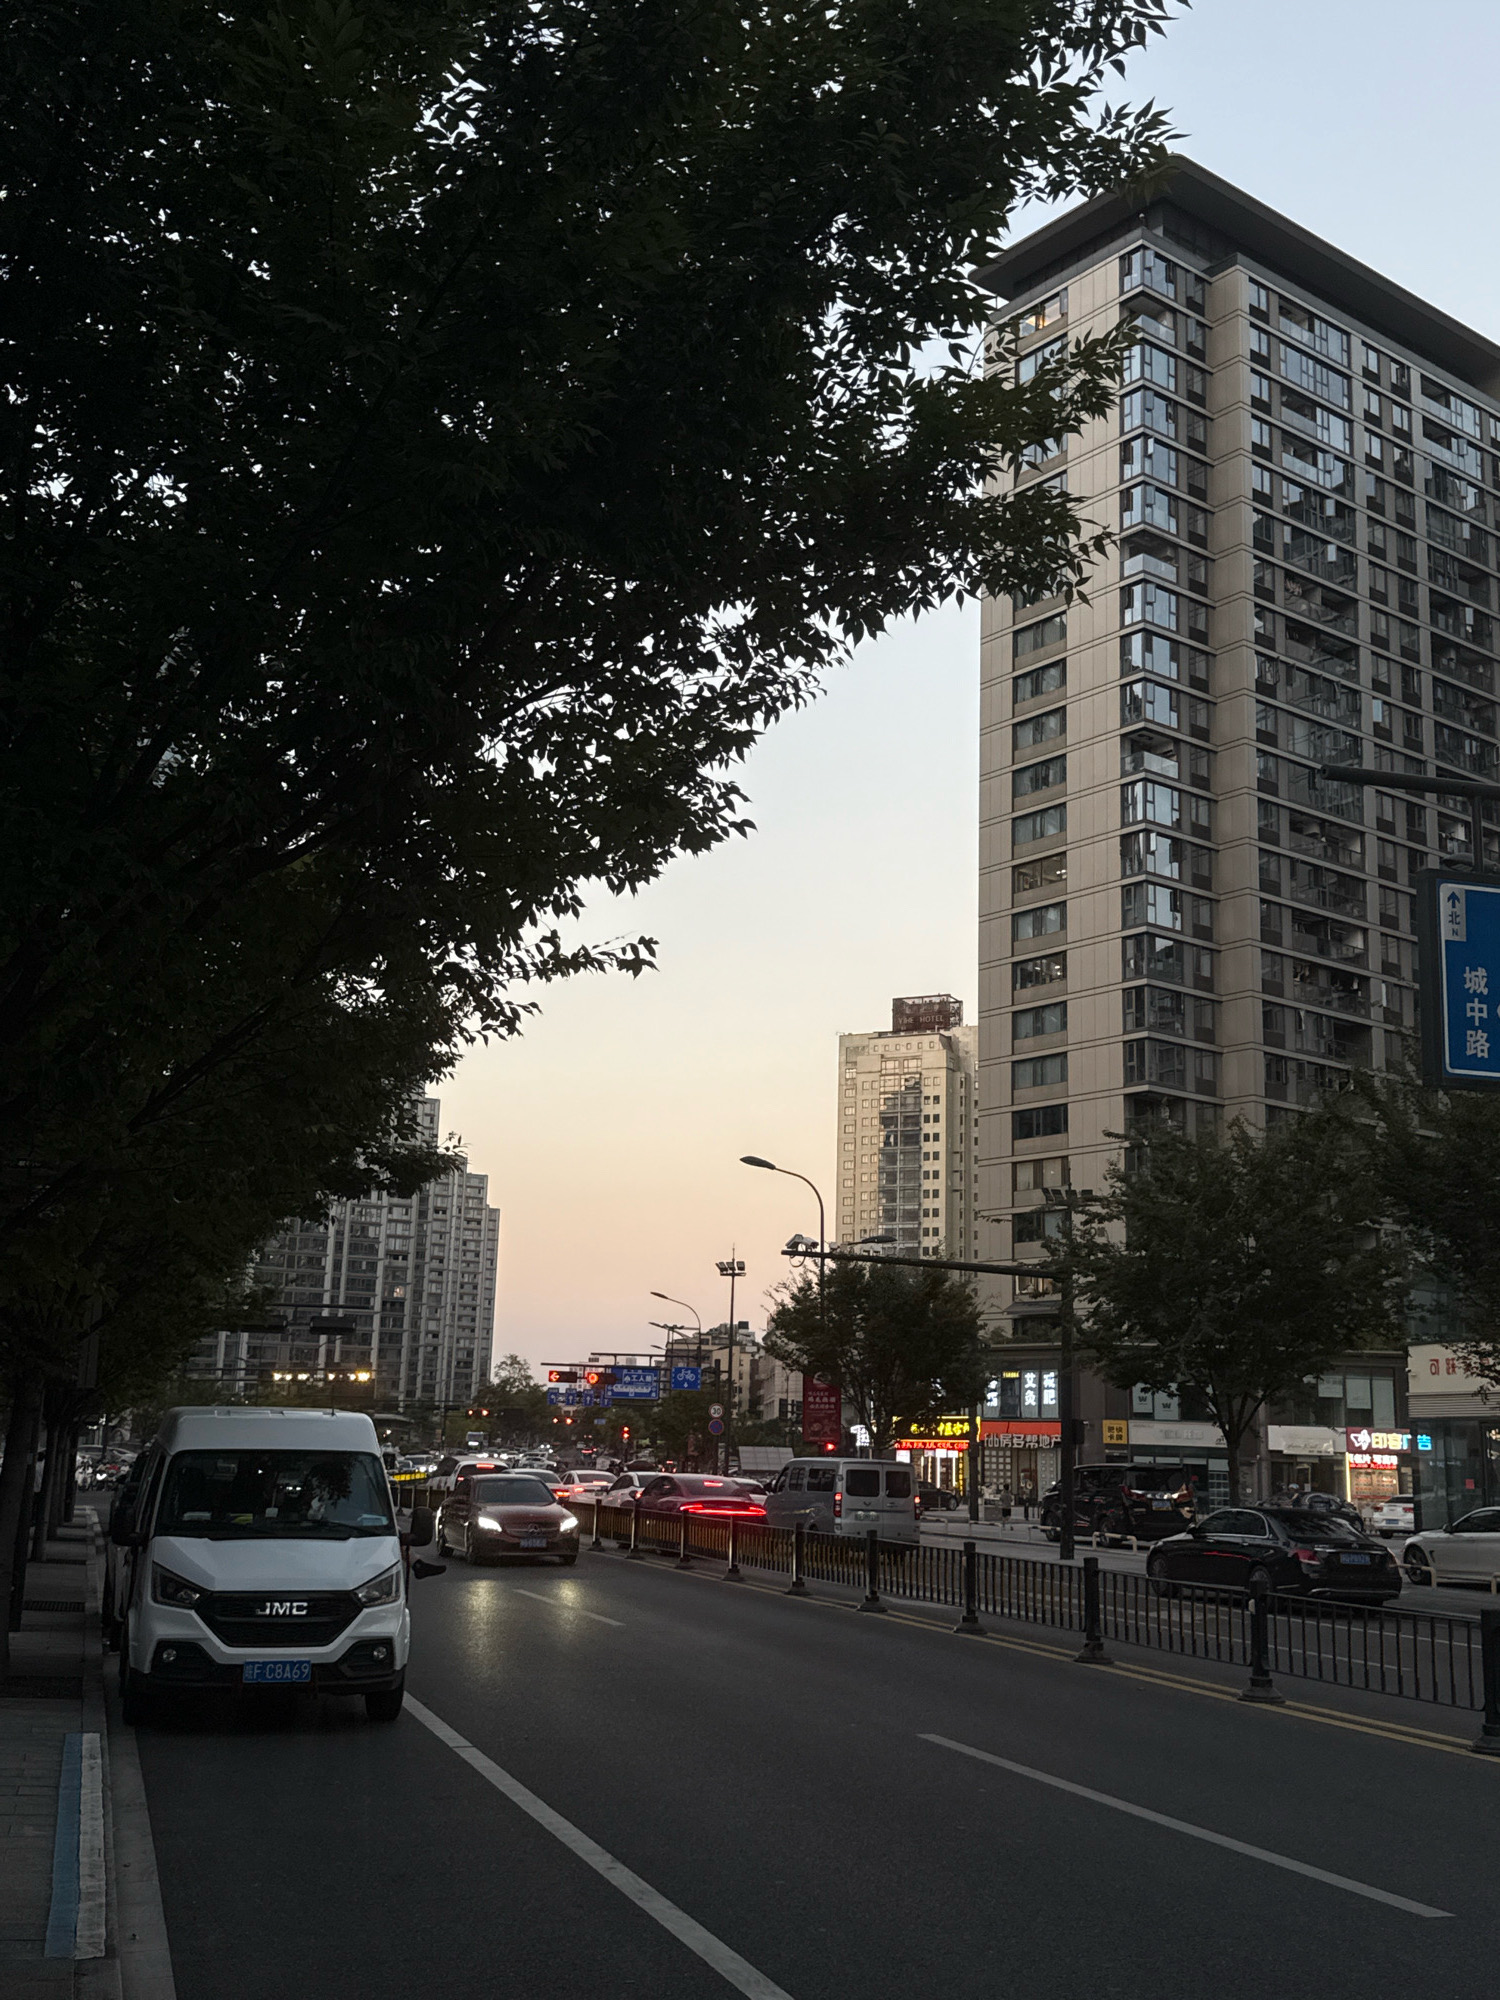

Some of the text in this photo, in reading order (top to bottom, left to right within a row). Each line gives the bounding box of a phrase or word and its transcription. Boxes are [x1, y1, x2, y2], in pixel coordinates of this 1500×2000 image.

[1448, 911, 1461, 926] 北
[1452, 928, 1458, 937] N
[919, 1015, 944, 1024] HOTEL
[1463, 966, 1491, 1059] 城中路
[1025, 1372, 1037, 1406] 艾灸
[712, 1407, 722, 1415] 30
[255, 1601, 309, 1616] JMC
